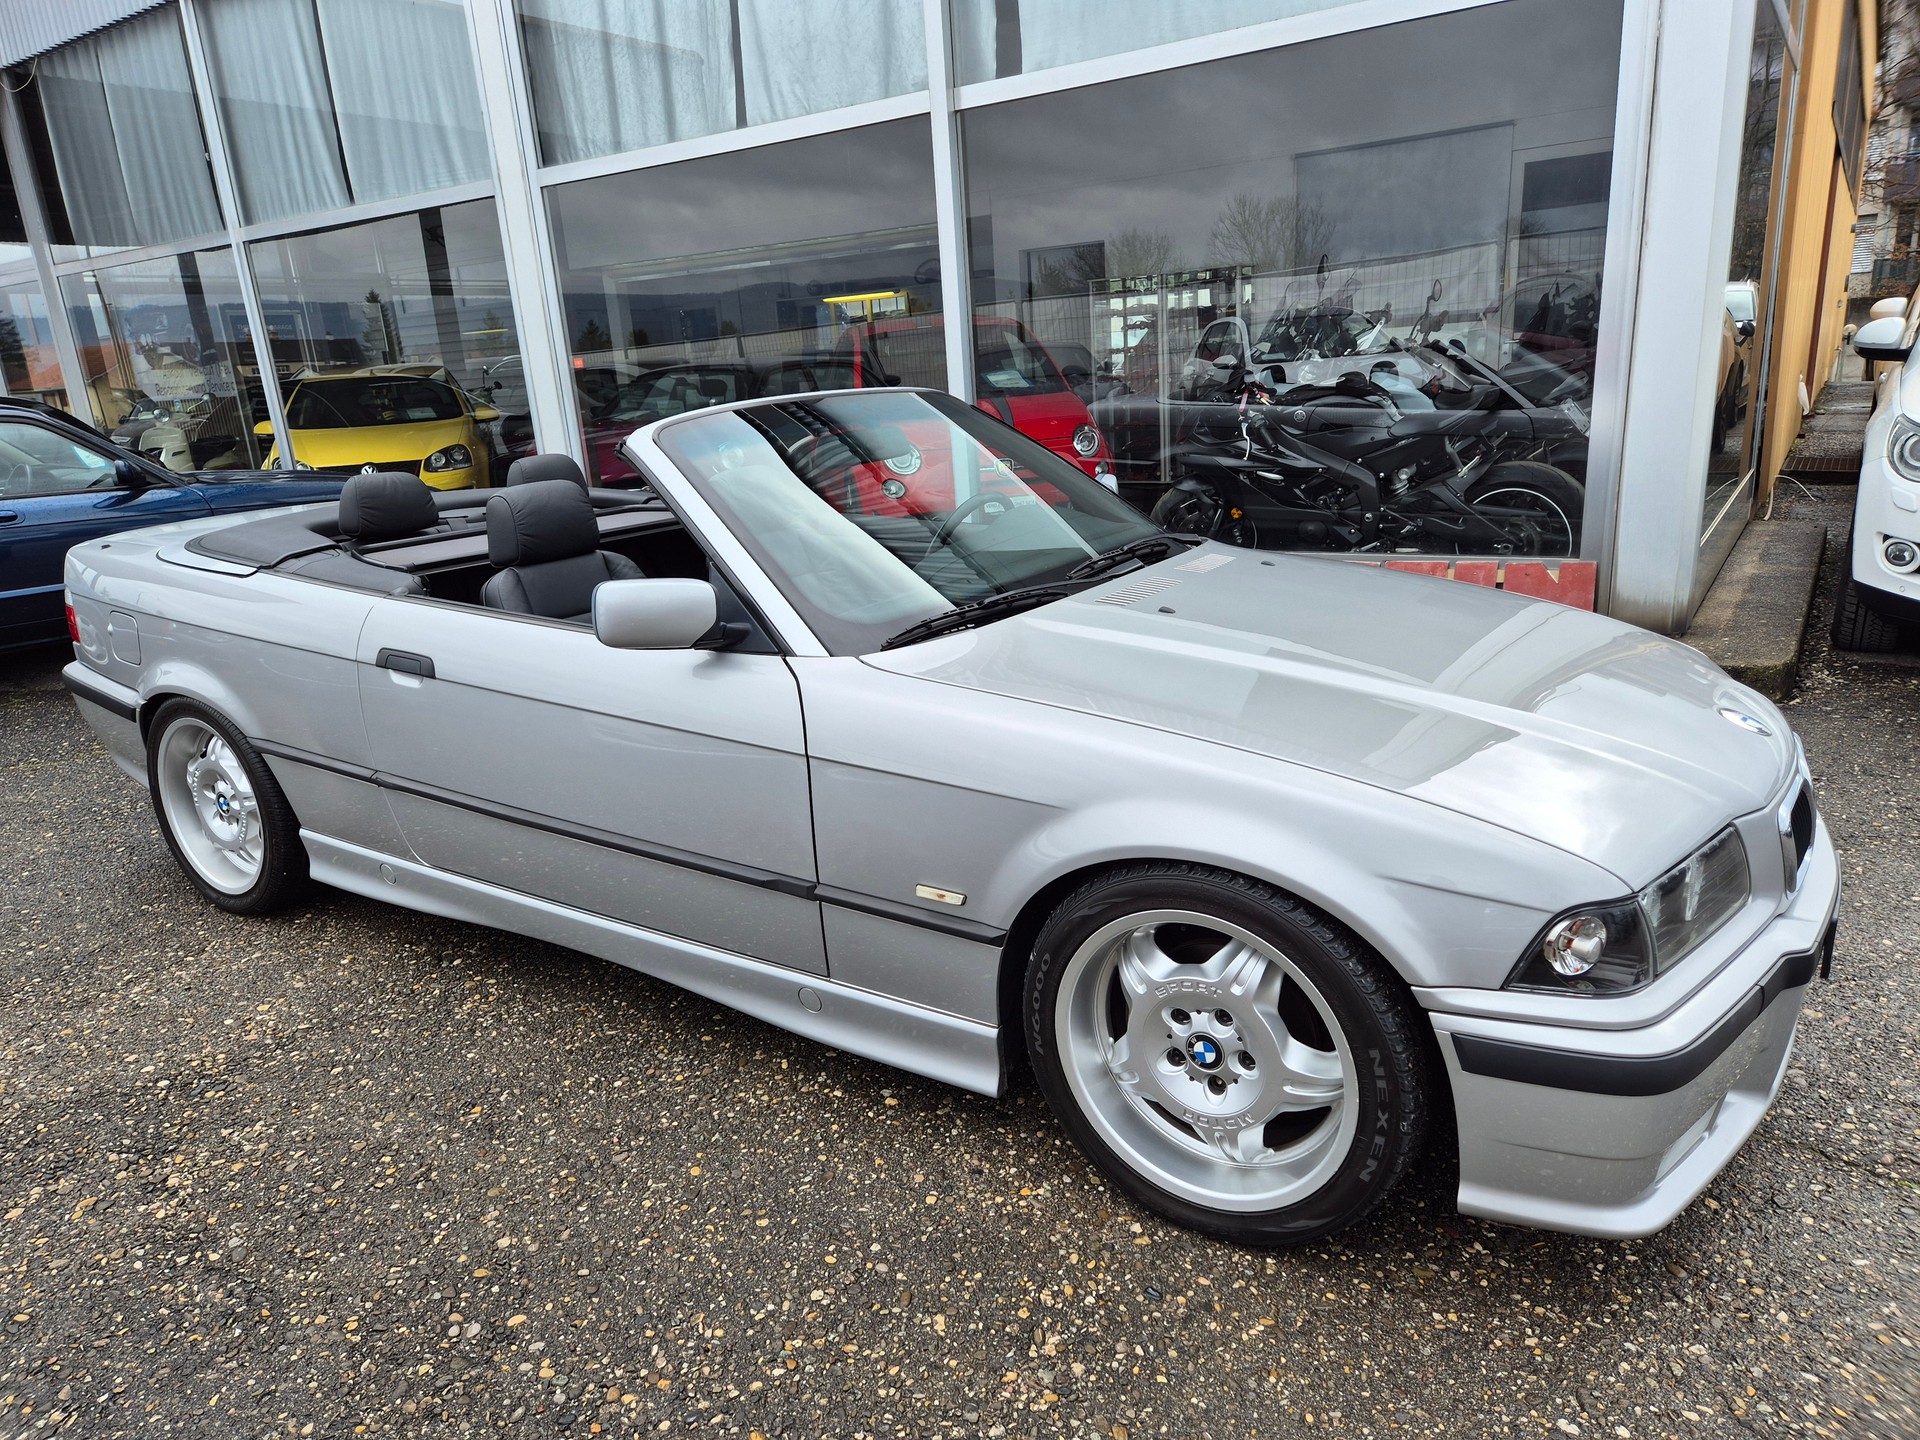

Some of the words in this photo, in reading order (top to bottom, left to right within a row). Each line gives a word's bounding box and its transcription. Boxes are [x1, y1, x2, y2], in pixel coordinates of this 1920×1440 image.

[1032, 953, 1051, 1055] N6000
[1155, 981, 1222, 999] SPORT
[1182, 1109, 1256, 1130] MOTOR
[1359, 1049, 1389, 1182] NEXEN
